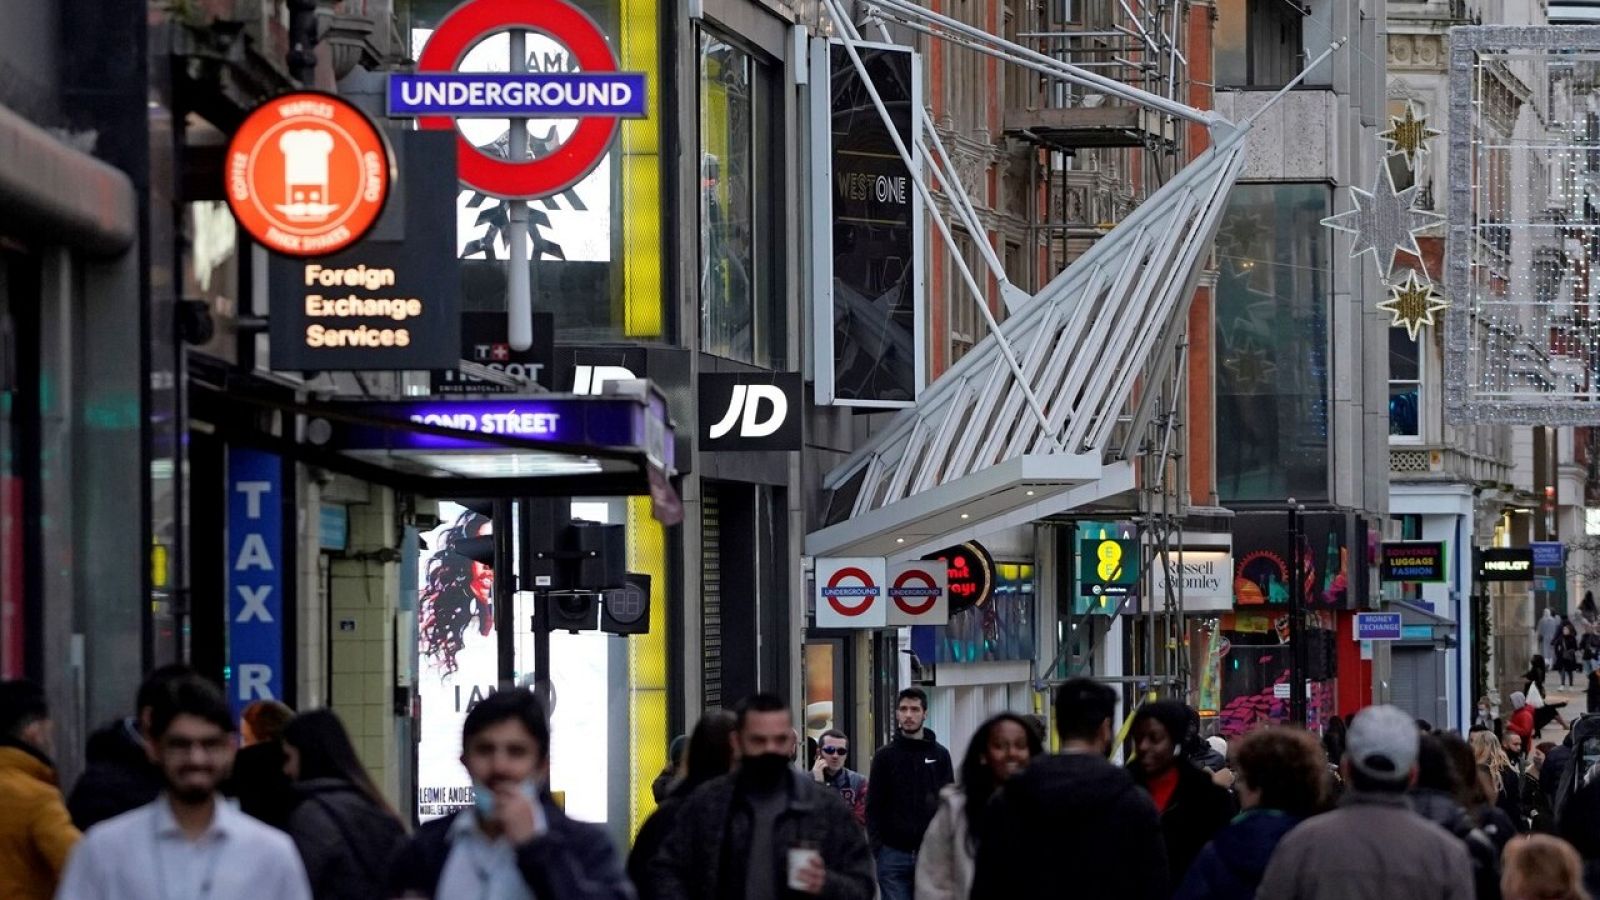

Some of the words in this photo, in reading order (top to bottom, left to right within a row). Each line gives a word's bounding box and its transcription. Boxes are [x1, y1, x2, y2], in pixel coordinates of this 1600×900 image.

[401, 81, 632, 106] UNDERGROUND
[305, 264, 395, 290] Foreign
[305, 295, 422, 320] Exchange
[305, 324, 411, 347] Services
[709, 384, 788, 439] JD
[480, 413, 560, 434] STREET
[1390, 557, 1434, 566] LUGGAGE
[1392, 567, 1433, 576] FASHION
[824, 587, 878, 596] UNDERGROUND
[890, 588, 940, 596] UNDERGROUND
[1365, 615, 1393, 623] MONEY
[1359, 623, 1400, 632] EXCHANGE
